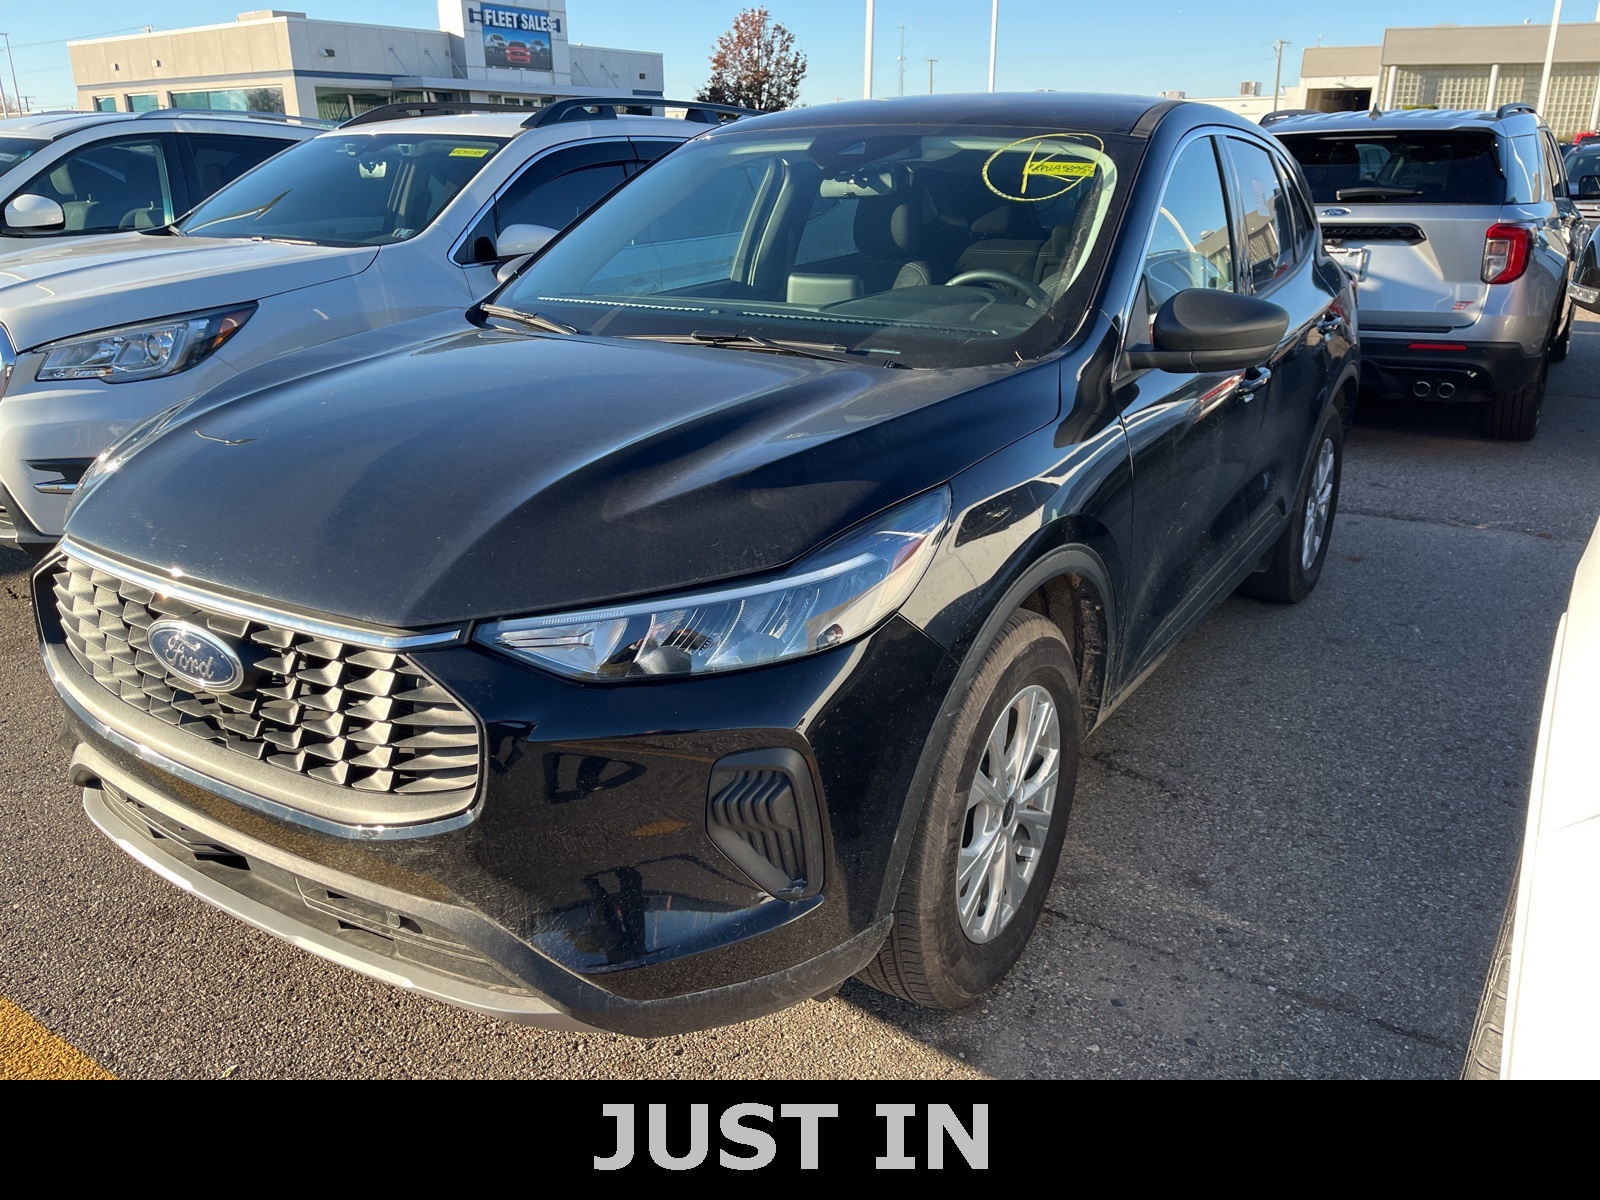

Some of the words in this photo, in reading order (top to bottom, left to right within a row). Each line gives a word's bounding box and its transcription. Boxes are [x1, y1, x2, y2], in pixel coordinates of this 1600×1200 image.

[483, 8, 519, 29] FLEET
[521, 13, 554, 32] SALES
[164, 635, 215, 680] Ford
